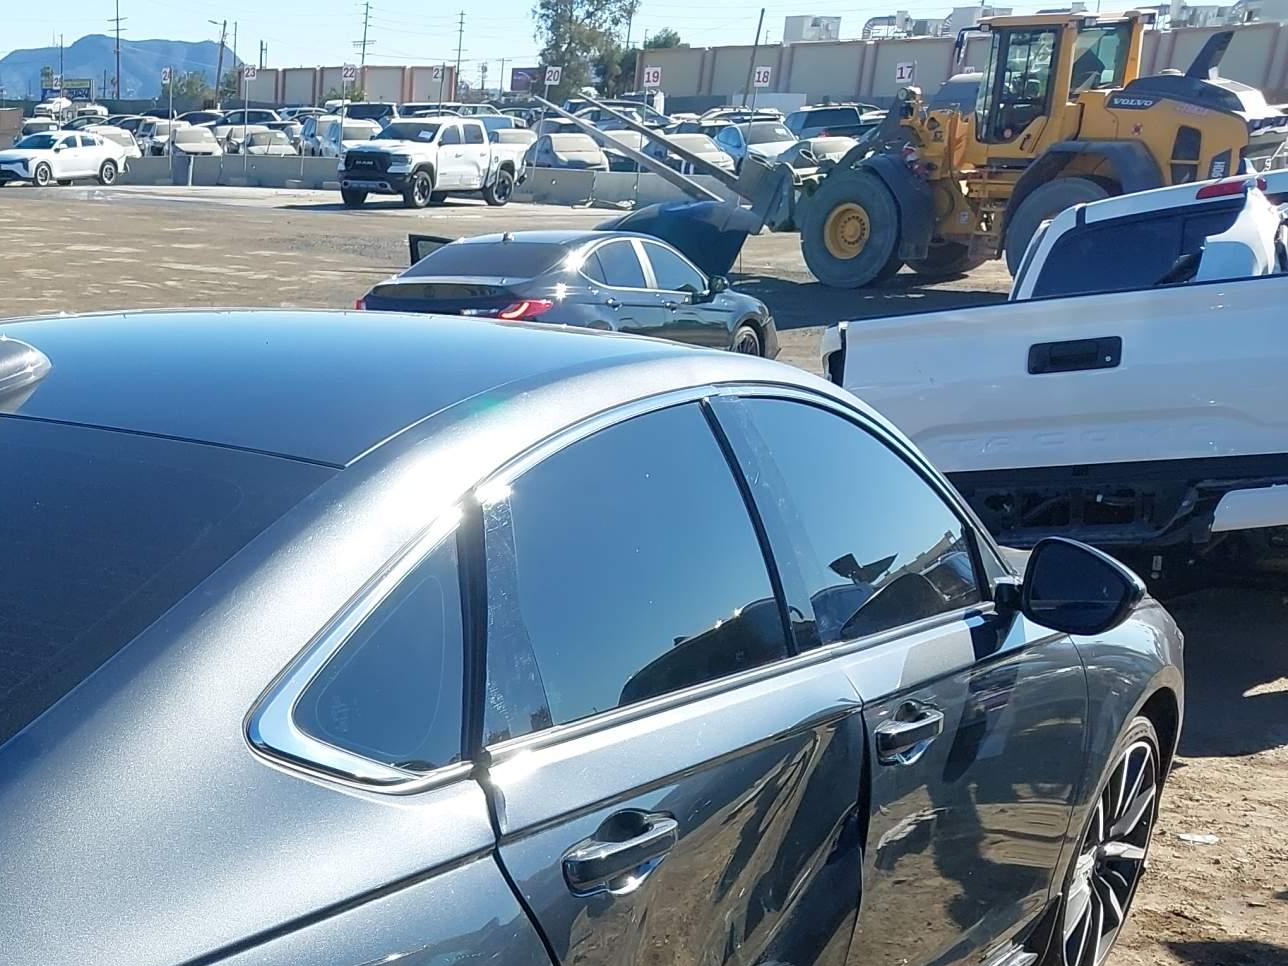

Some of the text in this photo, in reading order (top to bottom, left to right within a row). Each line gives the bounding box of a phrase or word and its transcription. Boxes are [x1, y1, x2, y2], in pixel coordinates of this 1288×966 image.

[244, 66, 256, 78] 23
[343, 67, 355, 78] 22
[547, 70, 560, 81] 20
[645, 70, 660, 83] 19
[756, 70, 770, 83] 18
[896, 65, 913, 80] 17
[1112, 97, 1153, 107] VOLVO
